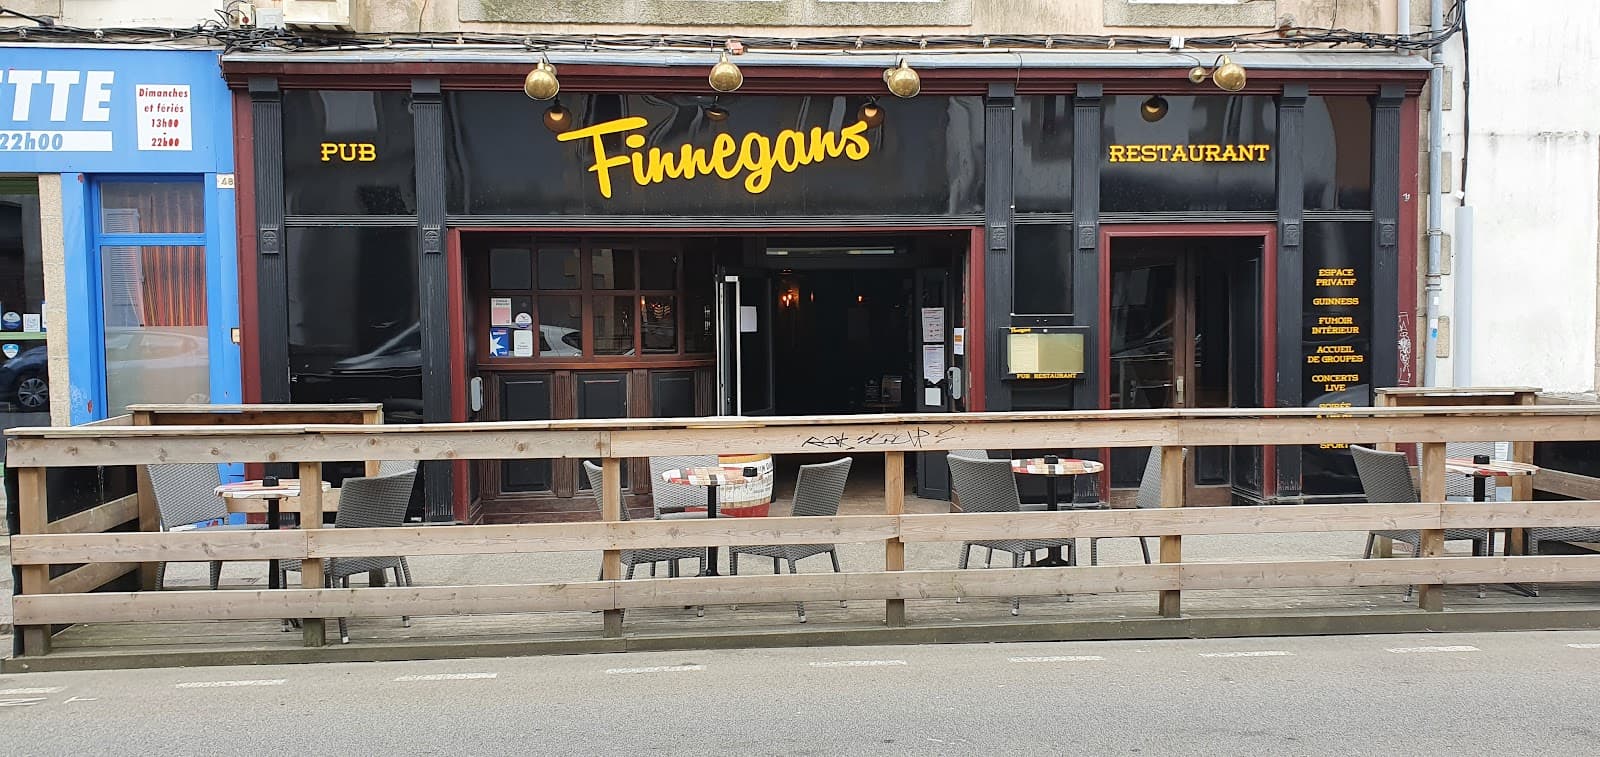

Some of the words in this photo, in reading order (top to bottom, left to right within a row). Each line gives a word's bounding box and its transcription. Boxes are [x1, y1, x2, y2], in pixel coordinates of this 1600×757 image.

[0, 69, 115, 122] TTE
[139, 87, 188, 98] Dimanches
[144, 104, 153, 113] et
[157, 102, 184, 113] fériés
[151, 118, 179, 128] 13h00
[0, 132, 63, 150] 22h00
[151, 136, 180, 147] 22h00
[321, 143, 377, 162] PUB
[556, 116, 870, 198] Finnegans
[1109, 144, 1270, 162] RESTAURANT
[220, 177, 234, 186] 48
[1318, 268, 1355, 277] ESPACE
[1315, 278, 1357, 287] PRIVATIF
[1312, 297, 1360, 306] GUINNESS
[1318, 316, 1353, 325] FUMOIR
[1311, 325, 1360, 335] INTÉRIEUR
[1316, 345, 1355, 354] ACCUEIL
[1307, 355, 1321, 363] DE
[1321, 354, 1364, 363] GROUPES
[1311, 374, 1359, 383] CONCERTS
[1325, 384, 1346, 392] LIVE
